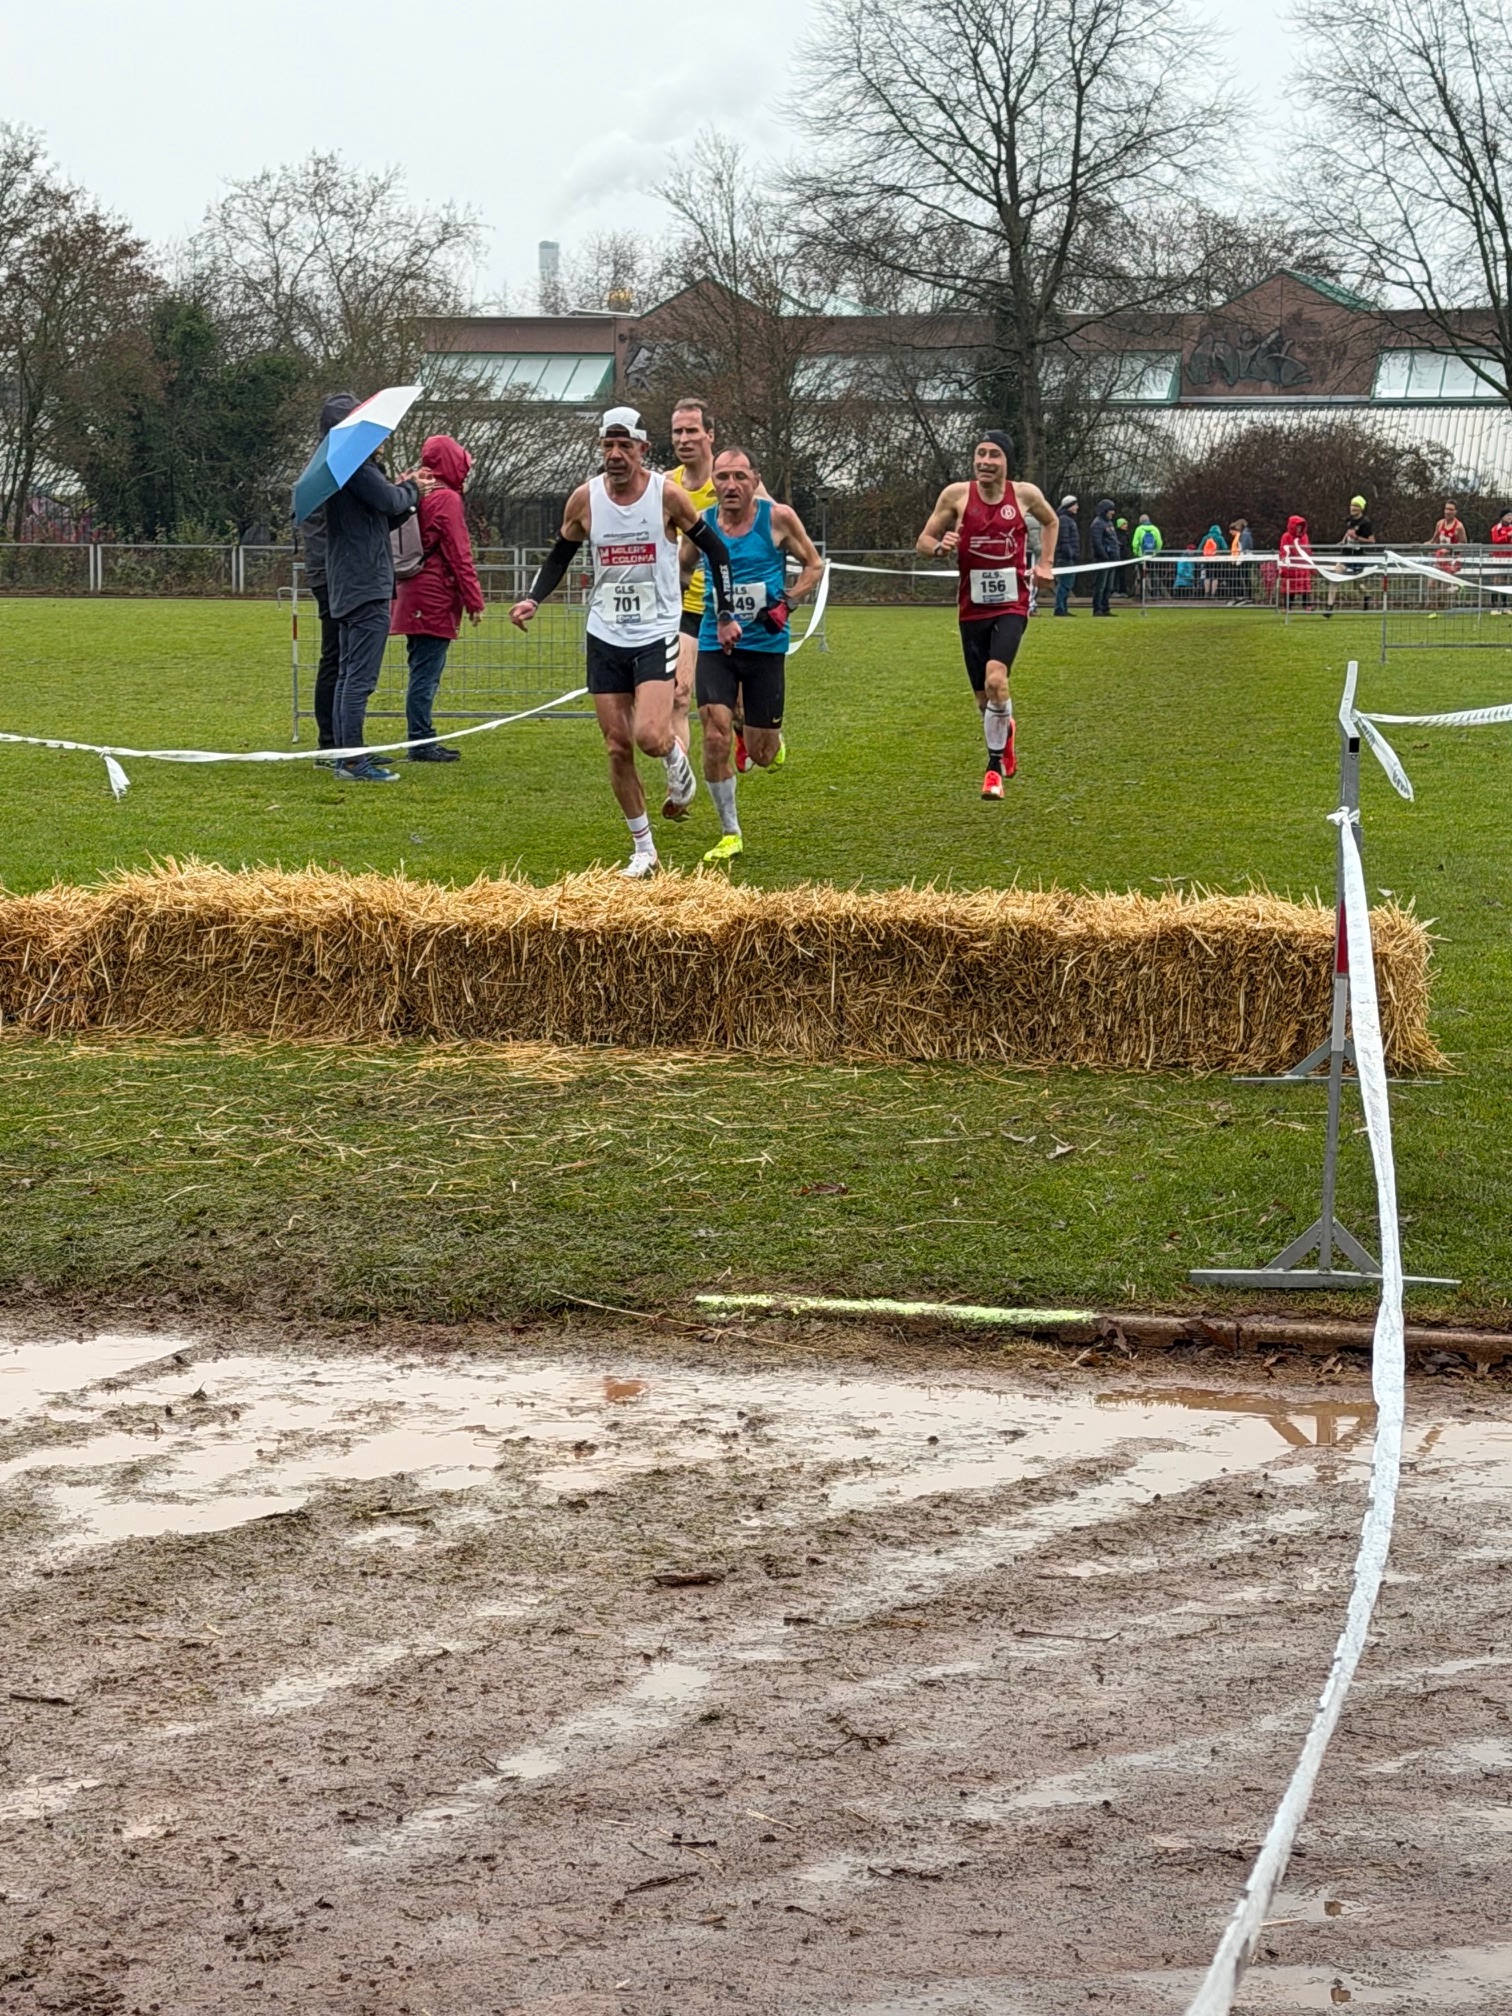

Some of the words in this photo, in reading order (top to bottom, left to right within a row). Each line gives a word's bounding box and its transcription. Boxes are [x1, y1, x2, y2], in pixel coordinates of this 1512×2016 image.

[611, 546, 647, 555] MILERS
[612, 554, 655, 564] COLONIA
[615, 585, 635, 594] GLS
[733, 586, 747, 594] LS
[980, 580, 1006, 593] 156
[613, 596, 641, 612] 701
